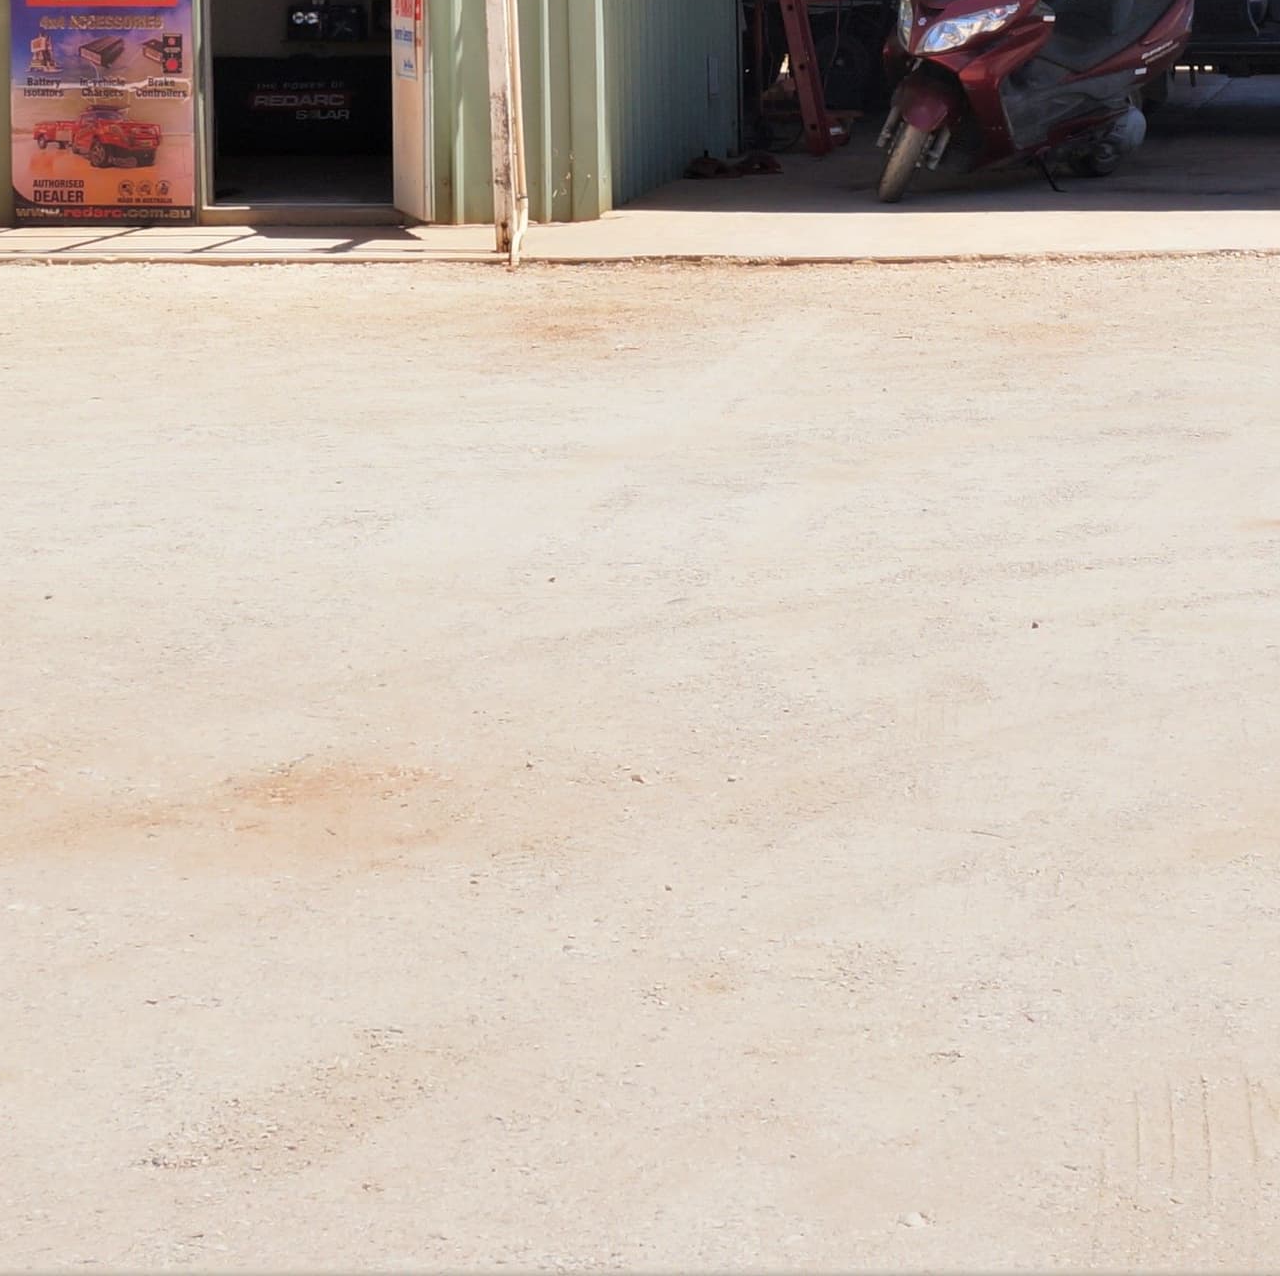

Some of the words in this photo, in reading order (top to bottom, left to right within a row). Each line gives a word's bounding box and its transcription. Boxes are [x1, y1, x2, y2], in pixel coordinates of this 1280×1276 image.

[27, 77, 61, 89] Battery
[254, 93, 345, 107] REDARC
[33, 179, 84, 189] AUTHORISED
[33, 190, 84, 203] DEALER
[15, 206, 191, 220] www.redarc.com.au
